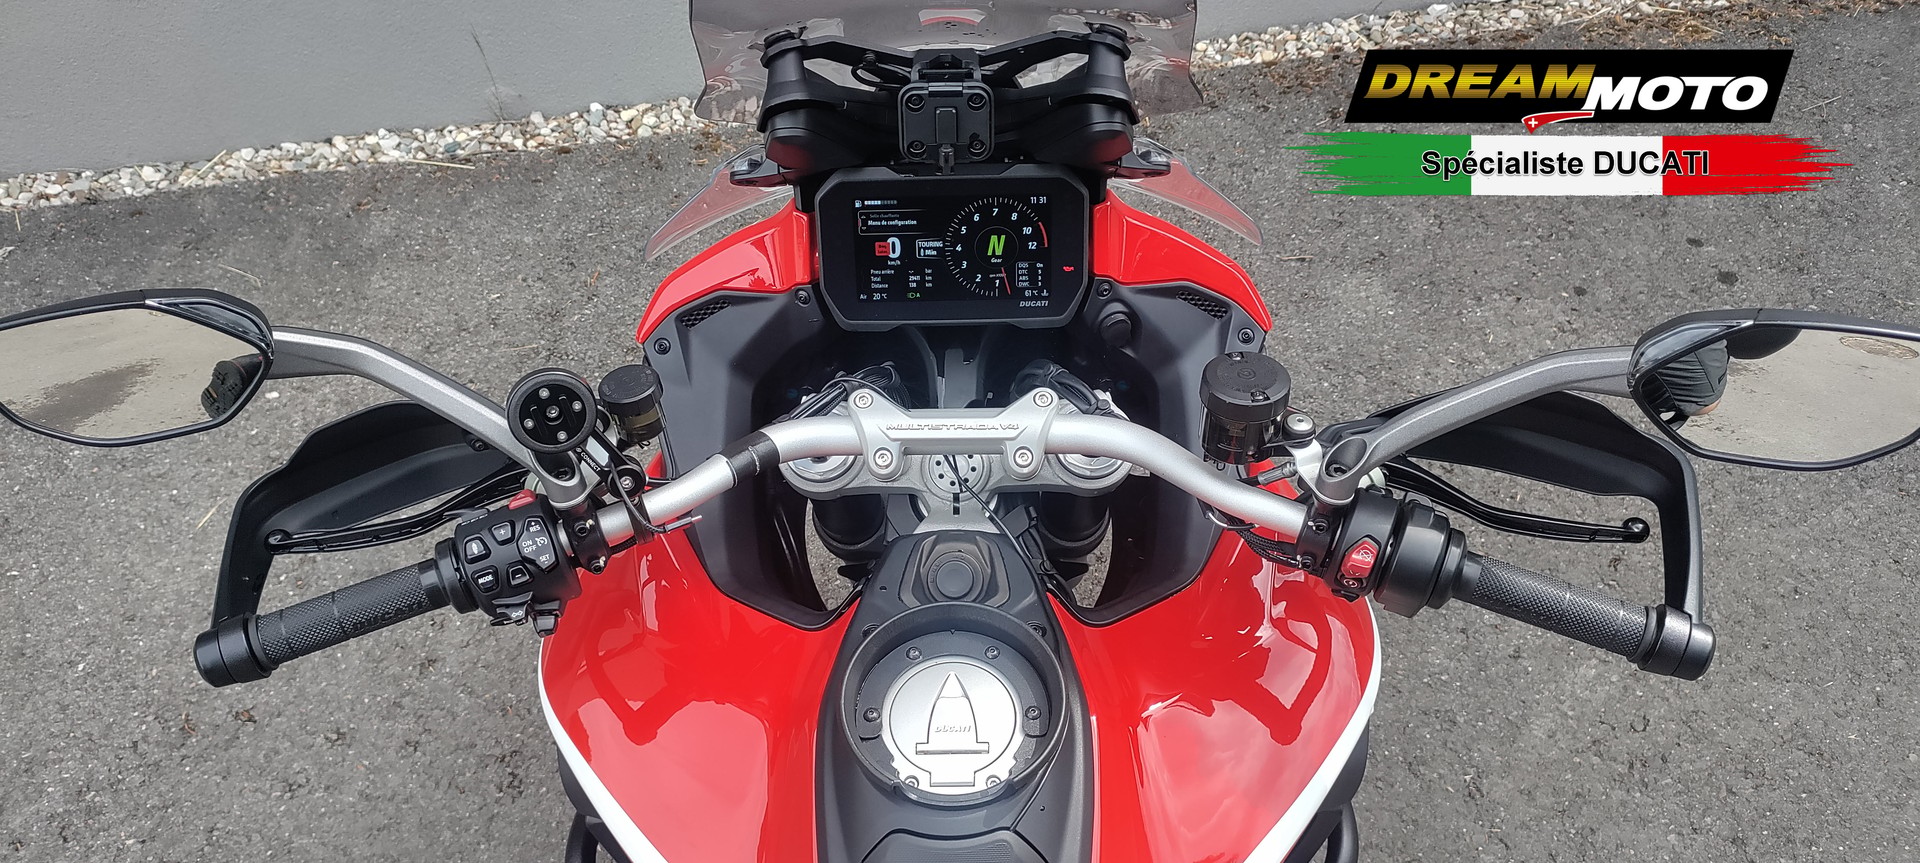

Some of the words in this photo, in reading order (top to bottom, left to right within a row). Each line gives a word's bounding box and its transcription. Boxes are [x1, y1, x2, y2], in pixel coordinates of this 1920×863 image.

[992, 208, 999, 216] 7
[973, 213, 980, 221] 6
[960, 226, 967, 234] 5
[1022, 227, 1032, 235] 10
[987, 235, 1006, 256] N
[1028, 241, 1037, 249] 12
[961, 260, 967, 269] 3
[975, 274, 982, 282] 2
[886, 423, 999, 431] MULTISTRADA
[1000, 423, 1020, 431] V4
[580, 452, 601, 472] CONNECT
[529, 525, 541, 533] RES
[522, 539, 533, 547] ON
[524, 545, 537, 553] OFF
[539, 554, 550, 562] SET
[478, 574, 494, 584] MODE
[935, 725, 971, 733] DUCATI
